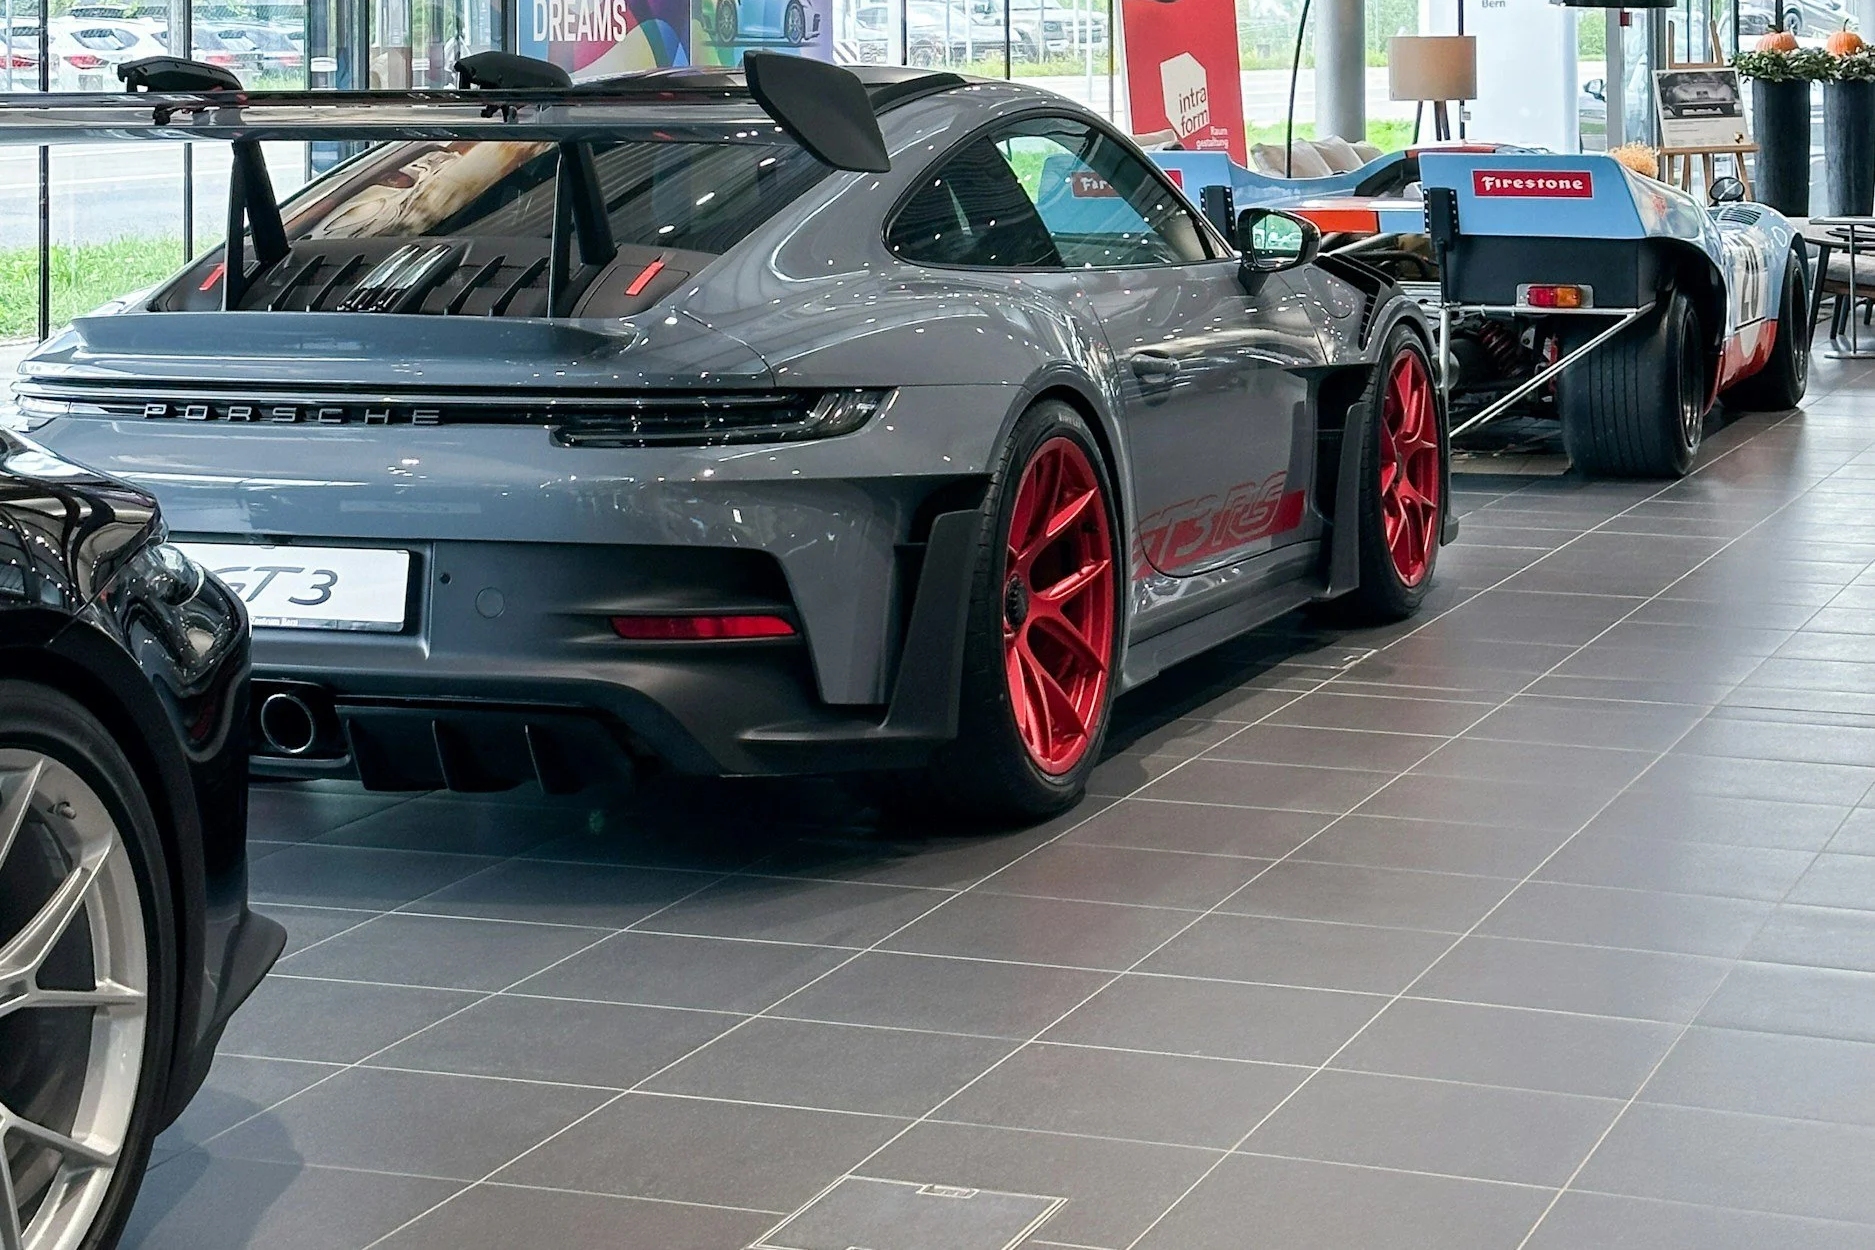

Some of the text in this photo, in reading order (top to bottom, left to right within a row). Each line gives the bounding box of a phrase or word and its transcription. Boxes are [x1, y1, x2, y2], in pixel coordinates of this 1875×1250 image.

[1178, 87, 1207, 114] intra
[1180, 110, 1209, 137] form
[1481, 176, 1584, 191] Firestone
[143, 403, 441, 425] PORSCHE
